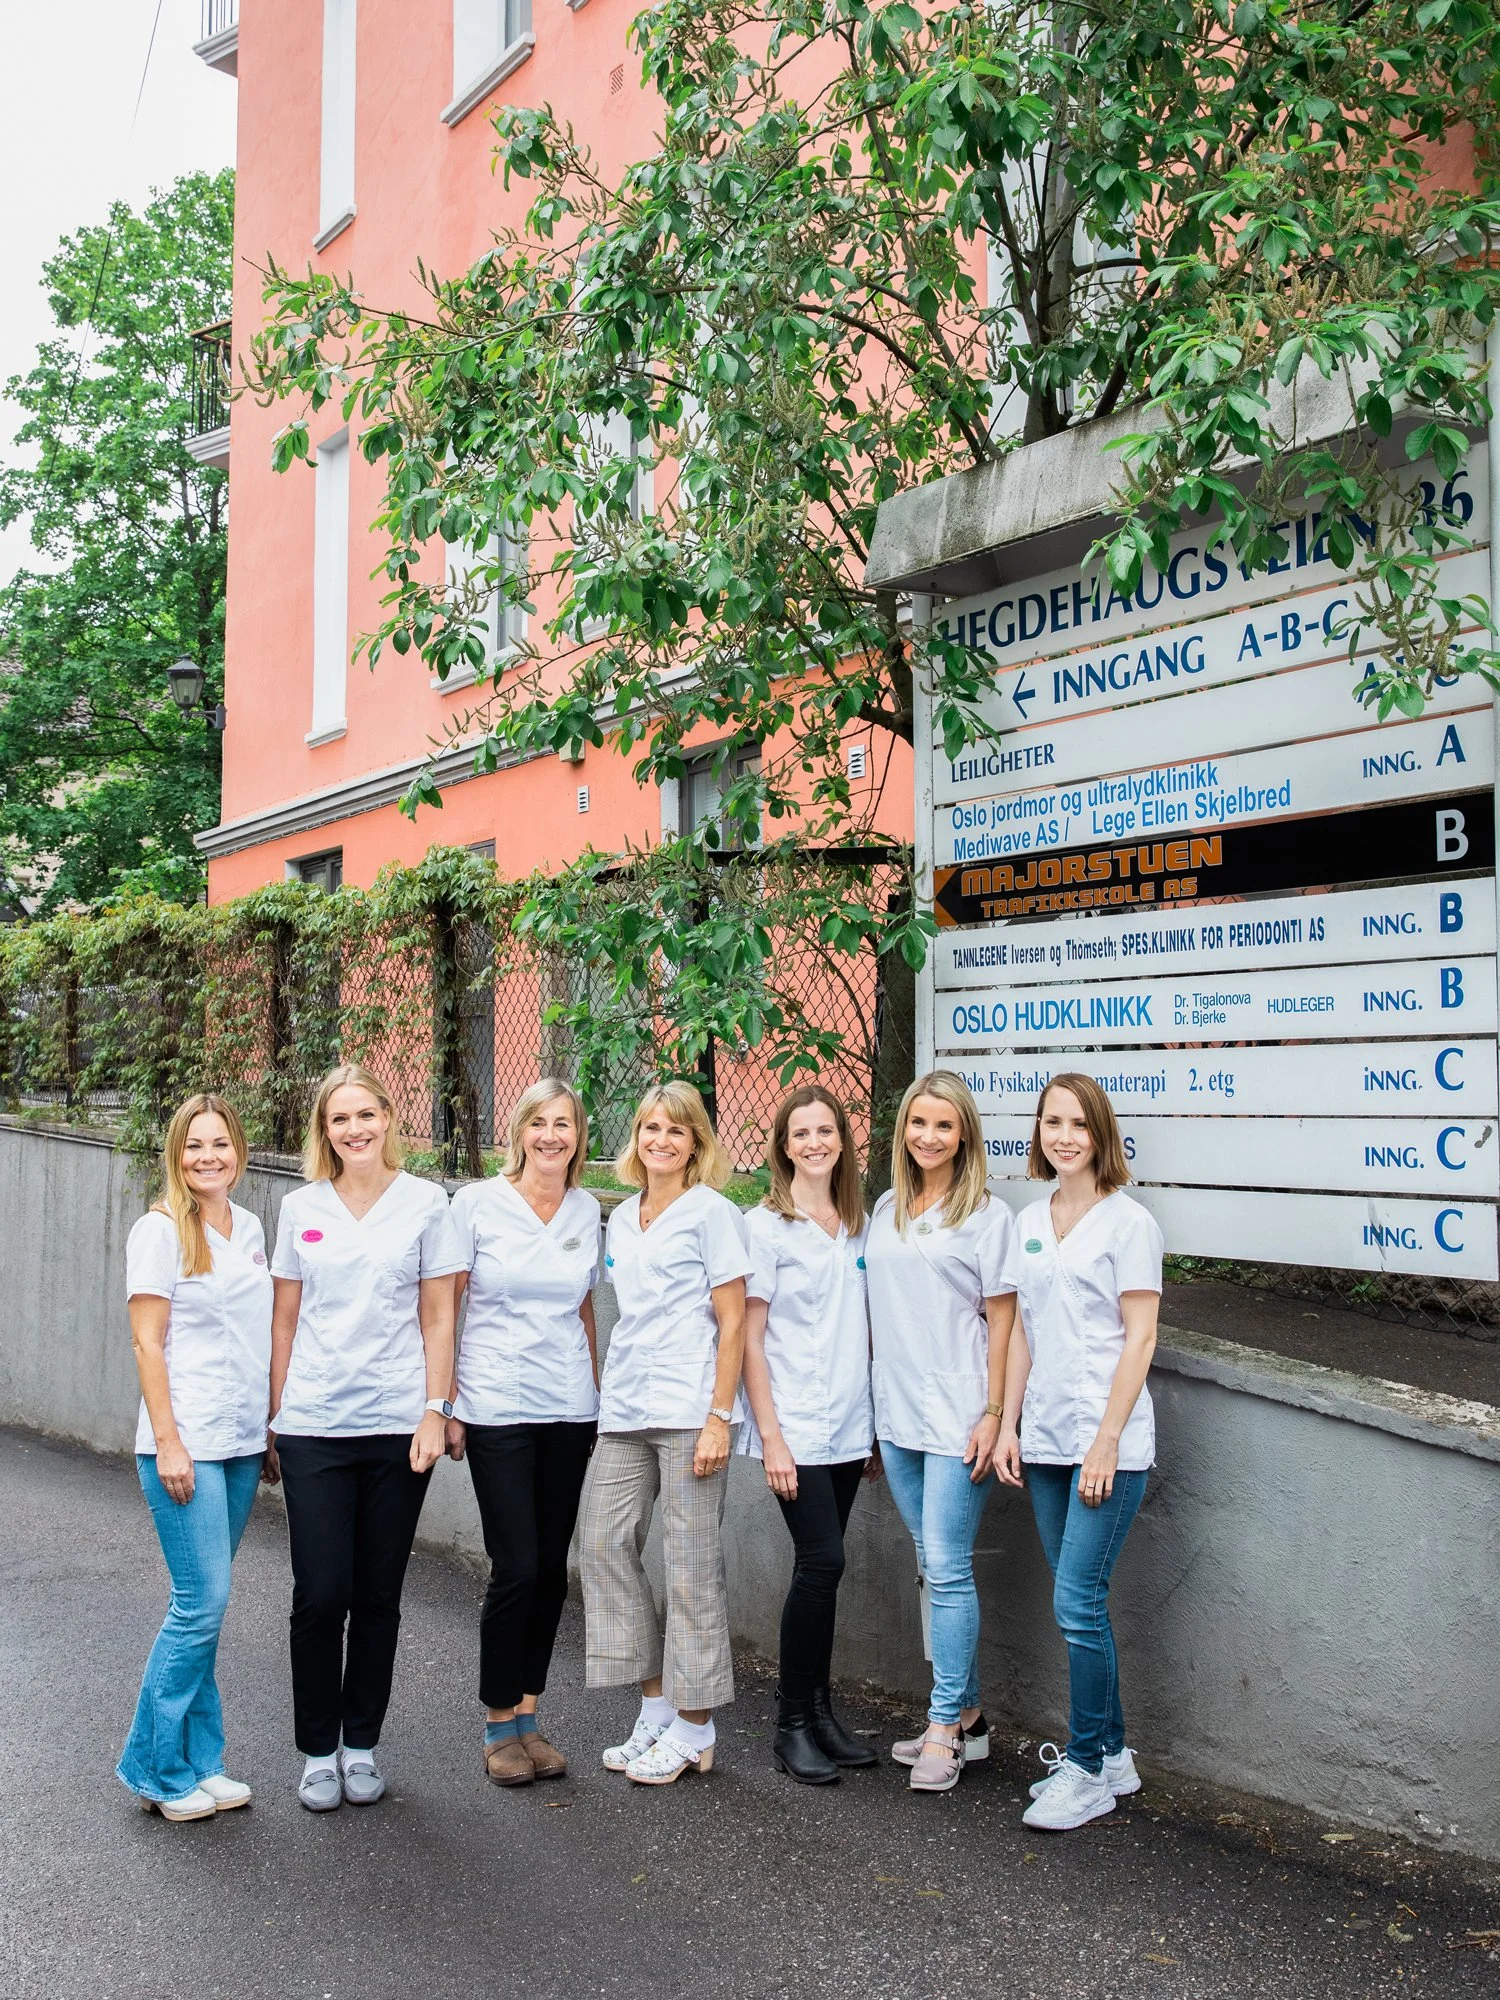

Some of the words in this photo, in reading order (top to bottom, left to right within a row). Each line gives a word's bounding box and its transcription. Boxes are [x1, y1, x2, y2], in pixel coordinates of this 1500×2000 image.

[1053, 636, 1206, 704] INNGANG
[1237, 600, 1349, 663] A-B-C
[951, 743, 1056, 783] LEILIGHETER
[1363, 750, 1422, 778] INNG.
[1435, 724, 1467, 766] A
[952, 803, 987, 830] Oslo
[990, 795, 1056, 830] jordmor
[1060, 790, 1082, 816] og
[1088, 761, 1219, 807] ultralydklinikk
[954, 828, 1031, 861] Mediwave
[1035, 819, 1059, 846] AS
[1064, 818, 1070, 842] /
[1093, 809, 1136, 838] Lege
[1142, 798, 1189, 827] Ellen
[1195, 779, 1291, 823] Skjelbred
[1435, 809, 1469, 862] B
[961, 836, 1223, 897] MAJORSTUEN
[981, 881, 1155, 918] TRAFIKKSKOLE
[1163, 876, 1198, 900] AS
[1362, 912, 1422, 937] INNG.
[1439, 892, 1464, 933] B
[953, 944, 1008, 969] TANNLEGENE
[1011, 943, 1046, 965] Iversen
[1050, 946, 1061, 967] og
[1065, 936, 1117, 961] Thomseth;
[1122, 928, 1196, 956] SPES.KLINIKK
[1201, 925, 1224, 950] FOR
[1229, 919, 1302, 947] PERIODONTI
[1309, 916, 1325, 942] AS
[1174, 994, 1189, 1008] Dr.
[1192, 992, 1251, 1009] Tigalonova
[1267, 996, 1335, 1014] HUDLEGER
[1363, 989, 1423, 1012] INNG.
[1440, 966, 1465, 1008] B
[952, 1003, 1008, 1034] OSLO
[1015, 995, 1153, 1031] HUDKLINIKK
[1174, 1012, 1189, 1025] Dr.
[1192, 1010, 1226, 1027] Bjerke
[1095, 1069, 1166, 1098] materapi
[1188, 1068, 1203, 1091] 2.
[1208, 1070, 1235, 1098] etg
[1435, 1047, 1465, 1091] C
[1365, 1146, 1424, 1169] INNG.
[1436, 1126, 1467, 1170] C
[1363, 1225, 1423, 1250] INNG.
[1434, 1208, 1465, 1253] C
